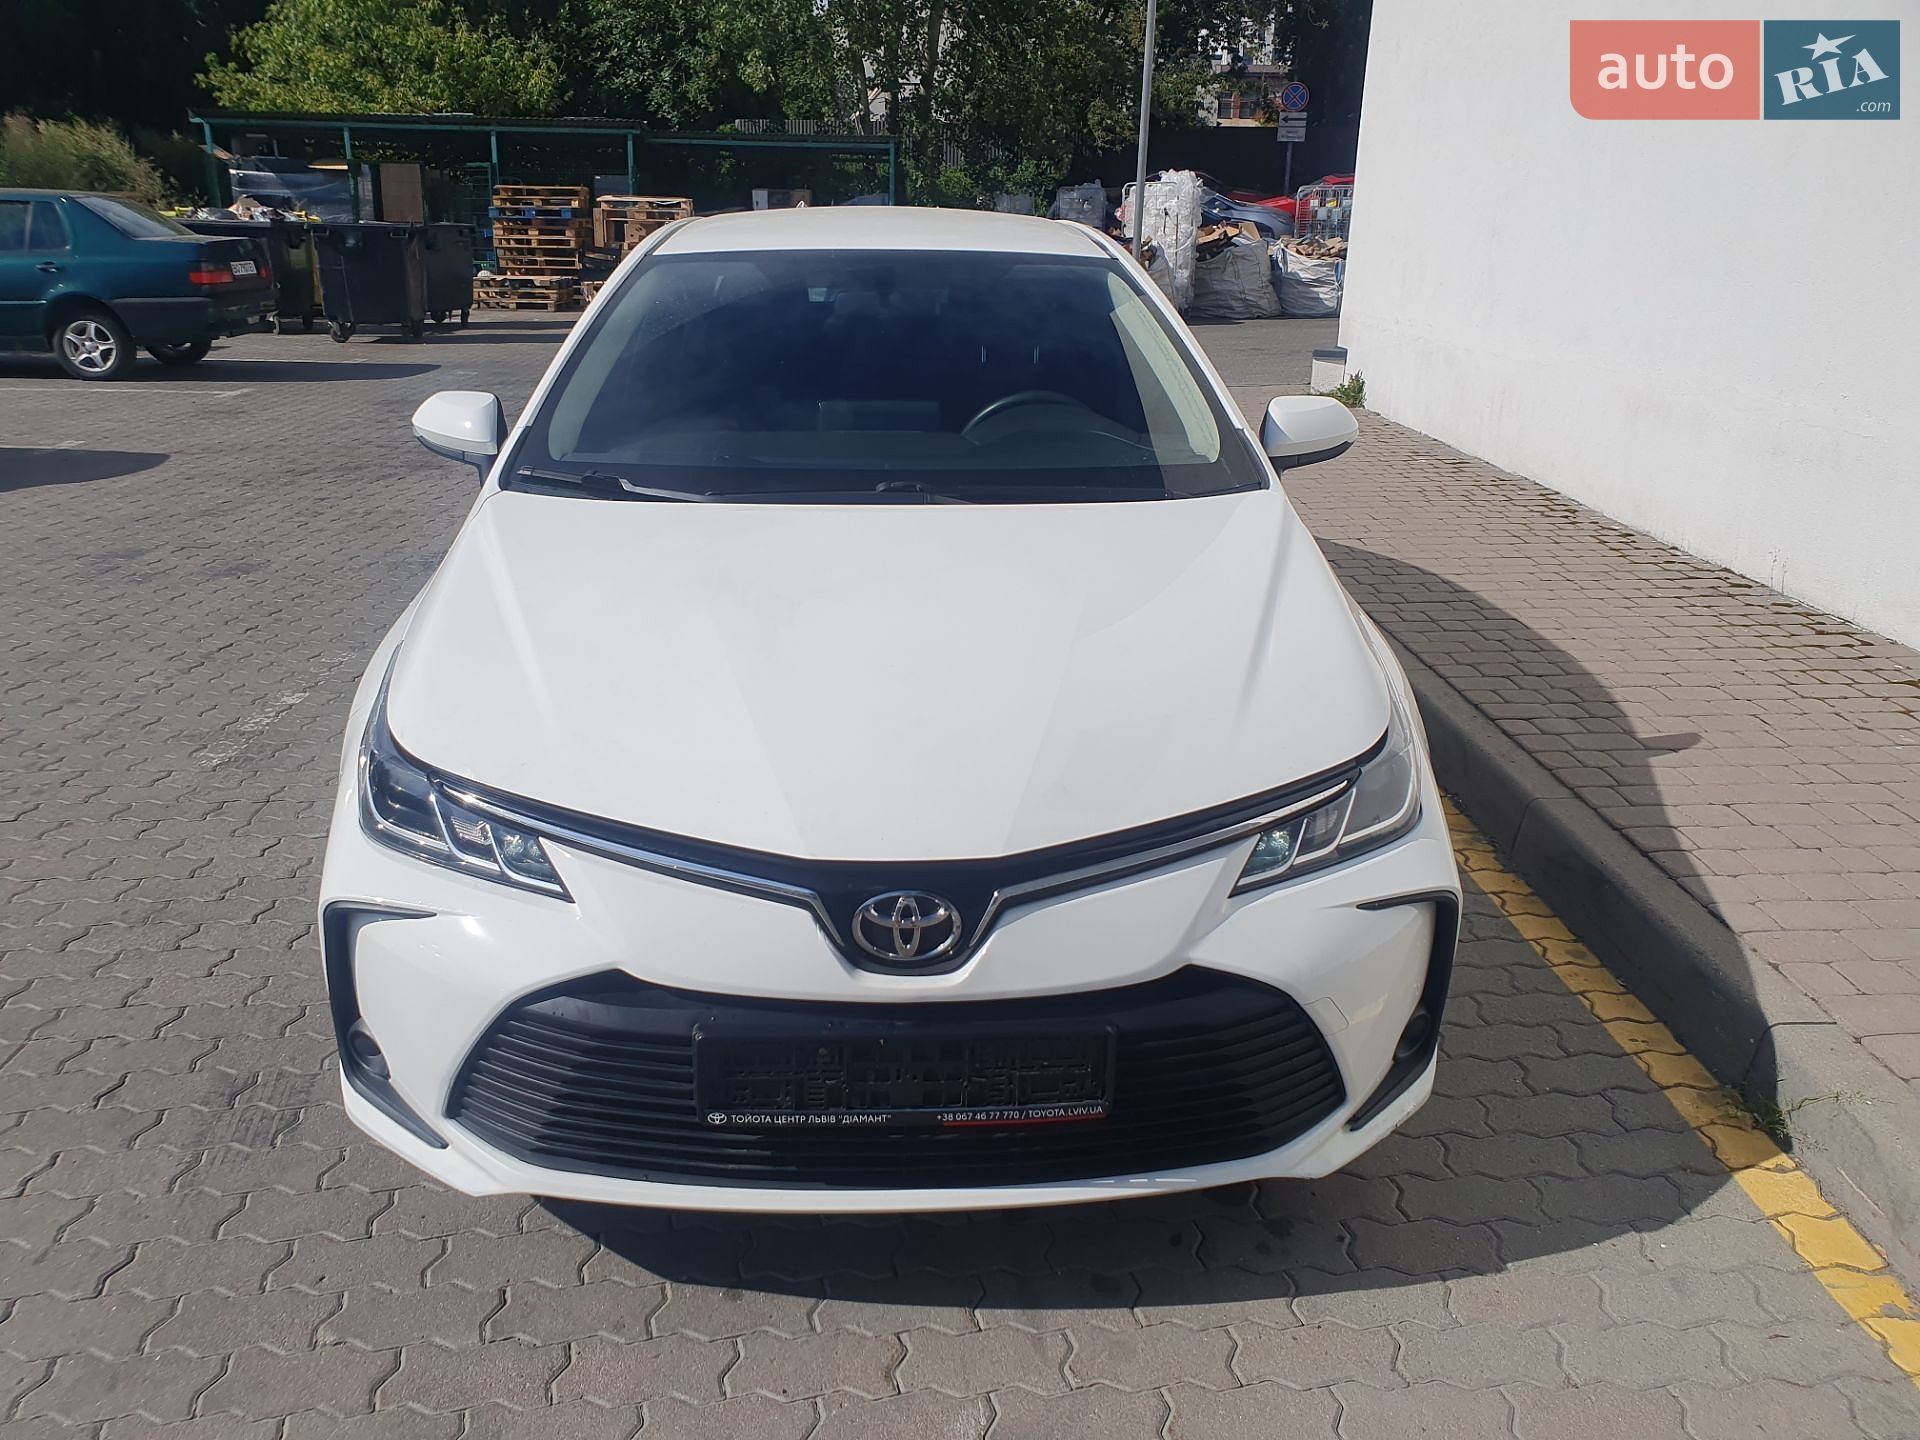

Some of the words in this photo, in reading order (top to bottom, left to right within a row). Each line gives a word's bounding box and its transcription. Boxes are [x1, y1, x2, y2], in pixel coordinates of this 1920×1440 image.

[731, 1113, 772, 1124] ТОЙОТА
[774, 1114, 806, 1125] ЦЕНТР
[808, 1114, 836, 1124] ЛЬВІВ
[838, 1113, 892, 1125] "ДІАМАНТ"
[936, 1112, 954, 1122] +38
[955, 1111, 973, 1121] 067
[975, 1111, 987, 1121] 46
[989, 1111, 1000, 1121] 77
[1002, 1110, 1020, 1120] 770
